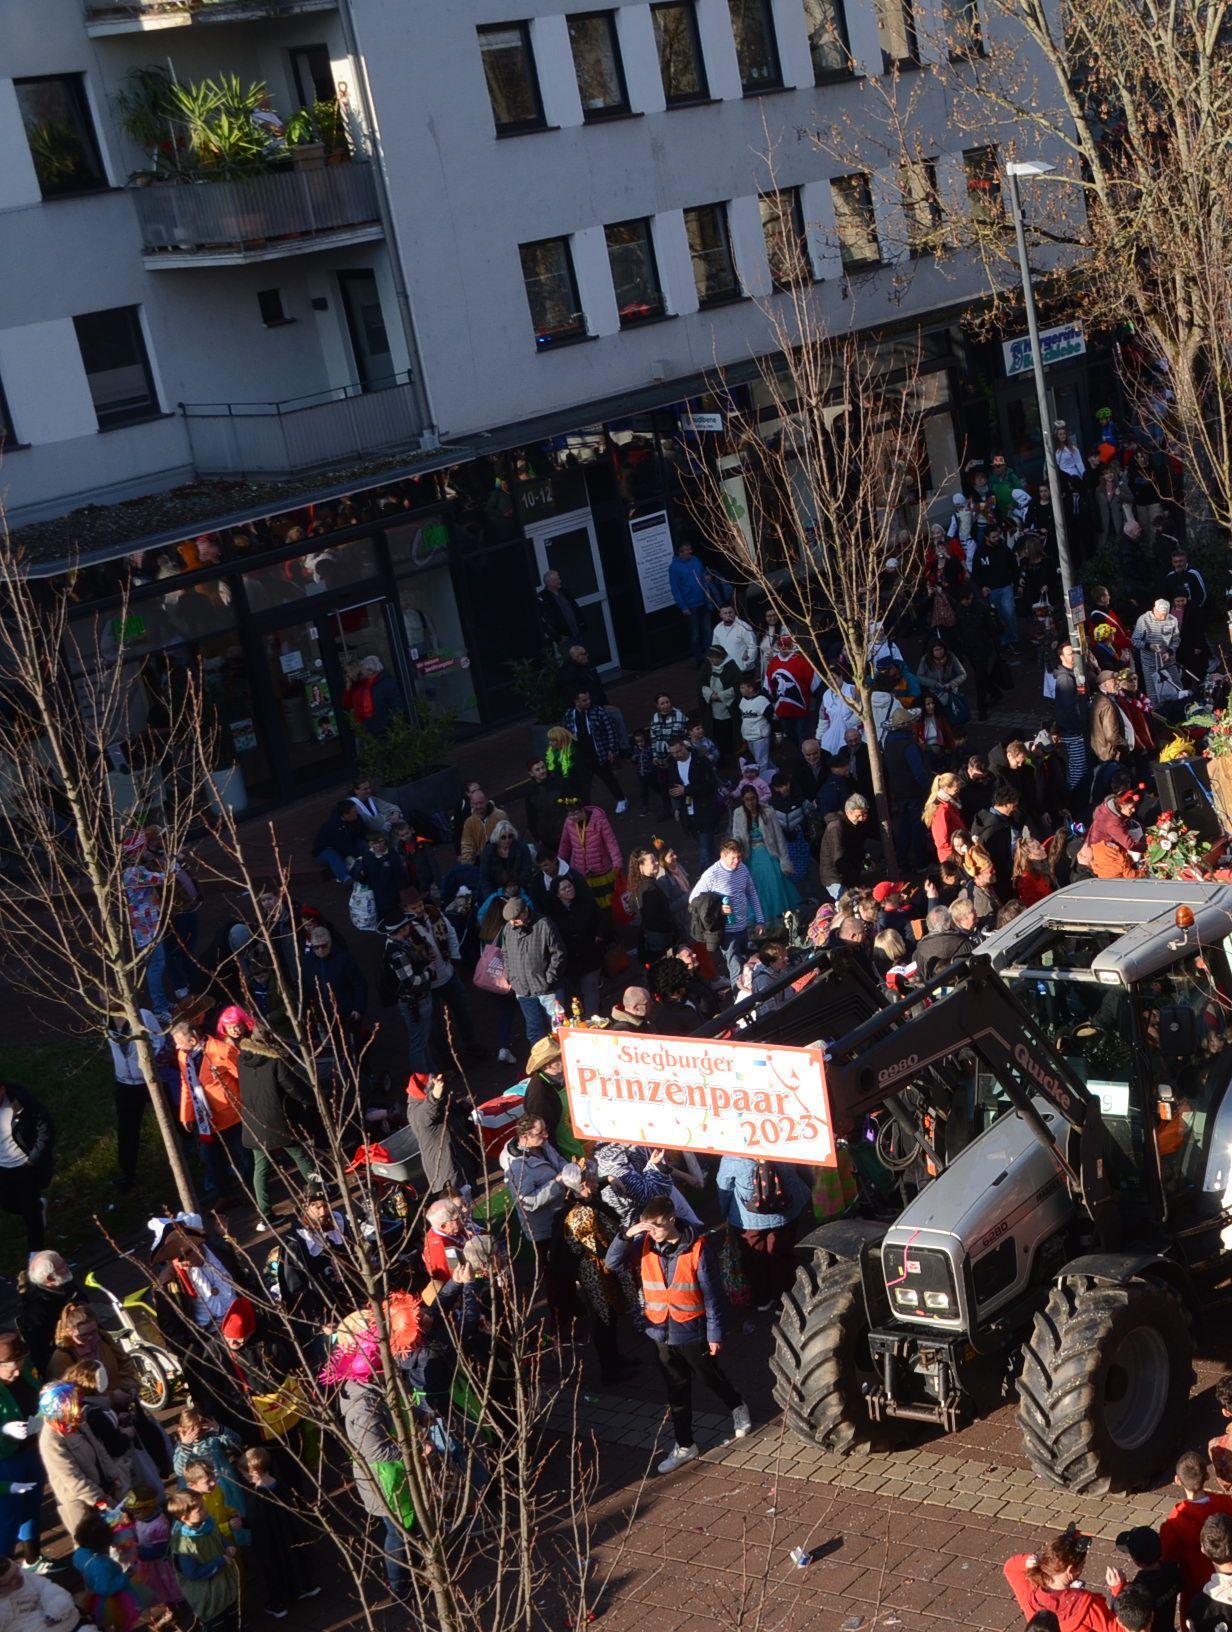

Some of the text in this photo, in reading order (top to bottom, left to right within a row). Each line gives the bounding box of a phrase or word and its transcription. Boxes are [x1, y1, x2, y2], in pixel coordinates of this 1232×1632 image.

[521, 486, 553, 509] 10-12
[980, 556, 990, 566] M
[619, 1045, 735, 1075] Siegburger
[878, 1054, 919, 1082] Q980
[577, 1066, 790, 1117] Prinzenpaar
[740, 1113, 819, 1147] 2023
[982, 1221, 1009, 1247] 6280
